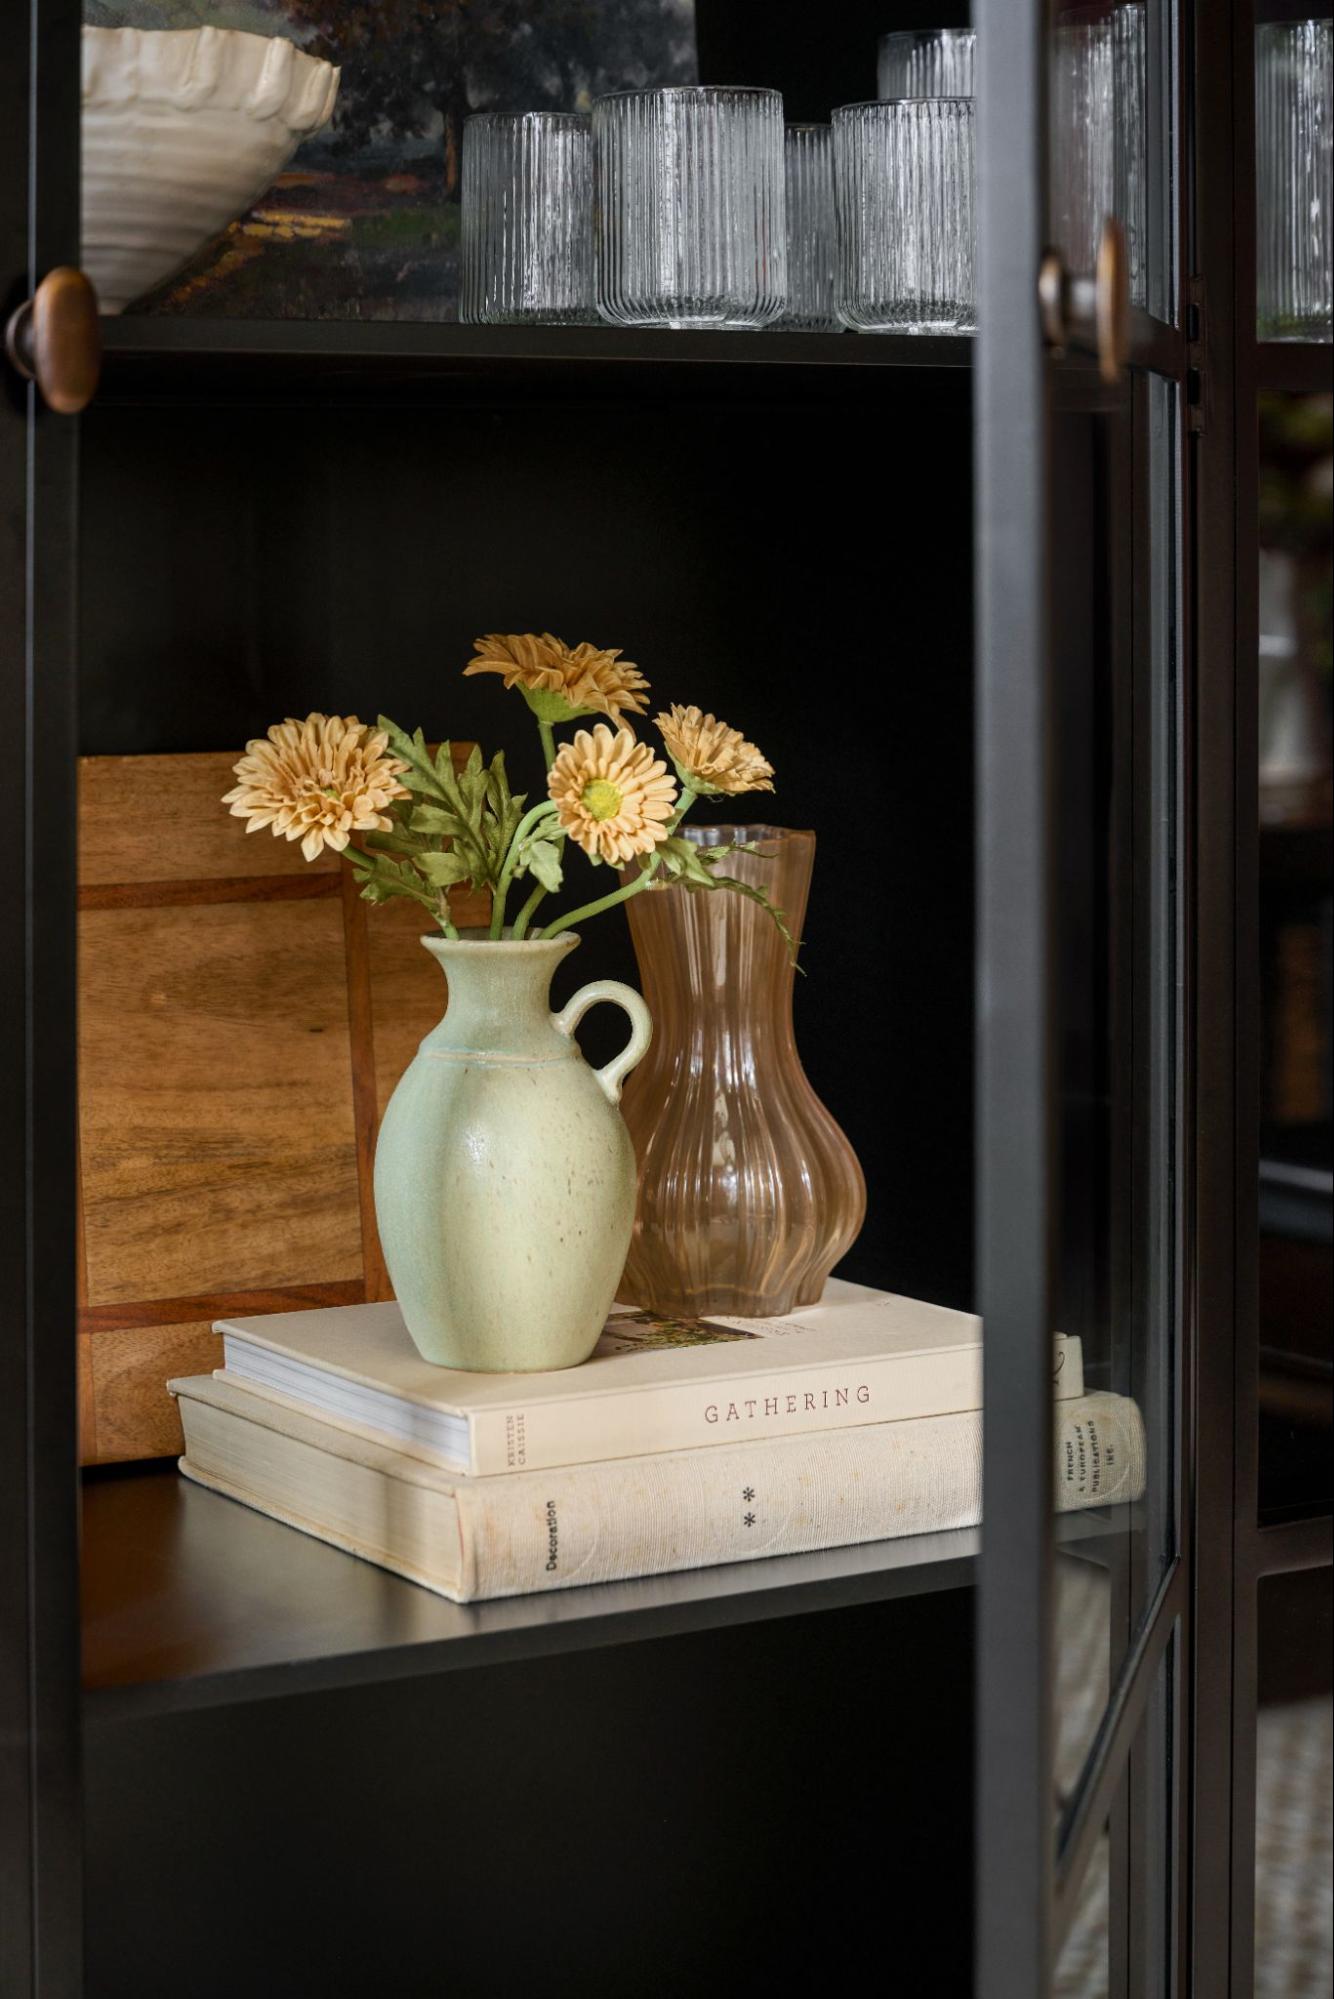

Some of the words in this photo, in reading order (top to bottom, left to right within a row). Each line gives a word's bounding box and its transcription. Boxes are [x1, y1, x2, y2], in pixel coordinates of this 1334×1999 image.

[704, 1385, 870, 1424] GATHERING
[1066, 1441, 1074, 1481] FRENCH
[1075, 1425, 1086, 1482] EUROPEAN
[1088, 1420, 1100, 1493] PUBLICATIONS
[1106, 1444, 1114, 1466] INC.
[545, 1500, 558, 1571] Decoration
